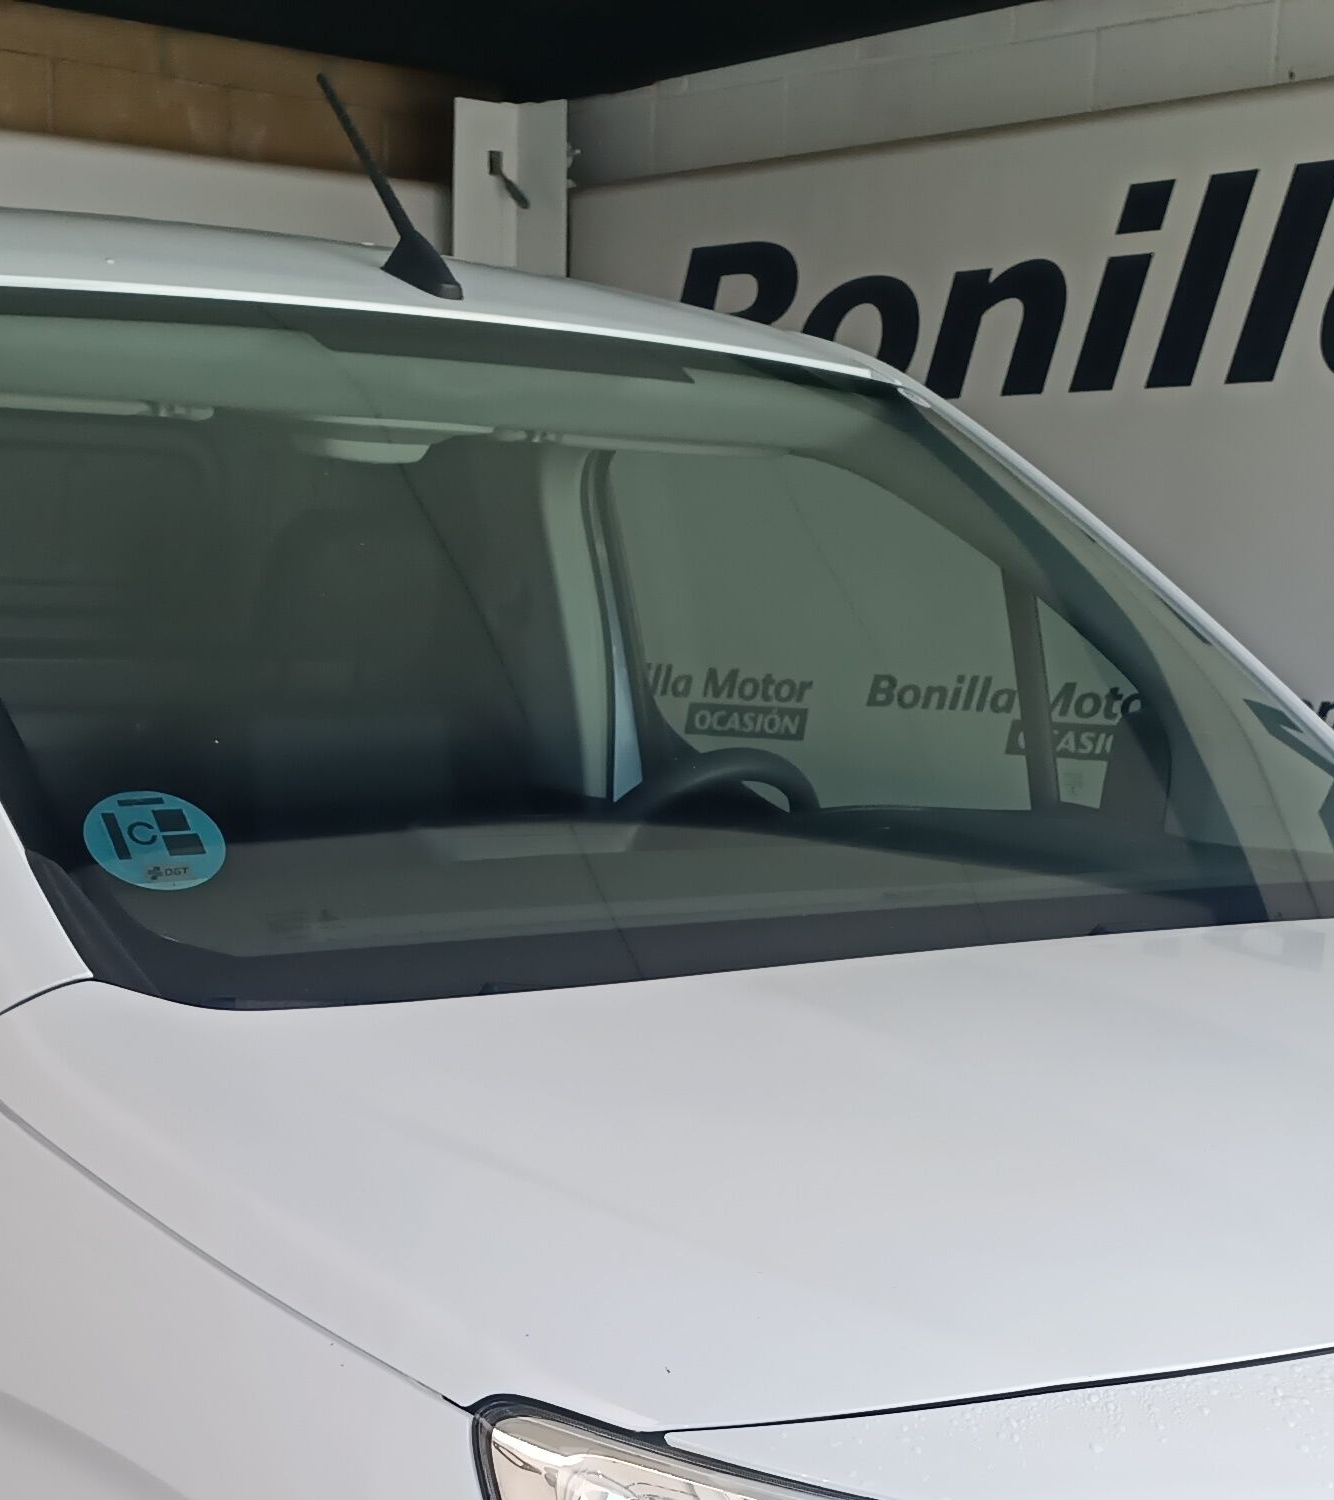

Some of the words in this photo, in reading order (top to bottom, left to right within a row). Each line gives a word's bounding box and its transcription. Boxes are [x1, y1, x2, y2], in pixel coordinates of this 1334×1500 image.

[703, 667, 813, 703] Motor
[865, 674, 1020, 714] Bonilla
[694, 708, 800, 735] OCASIÓN
